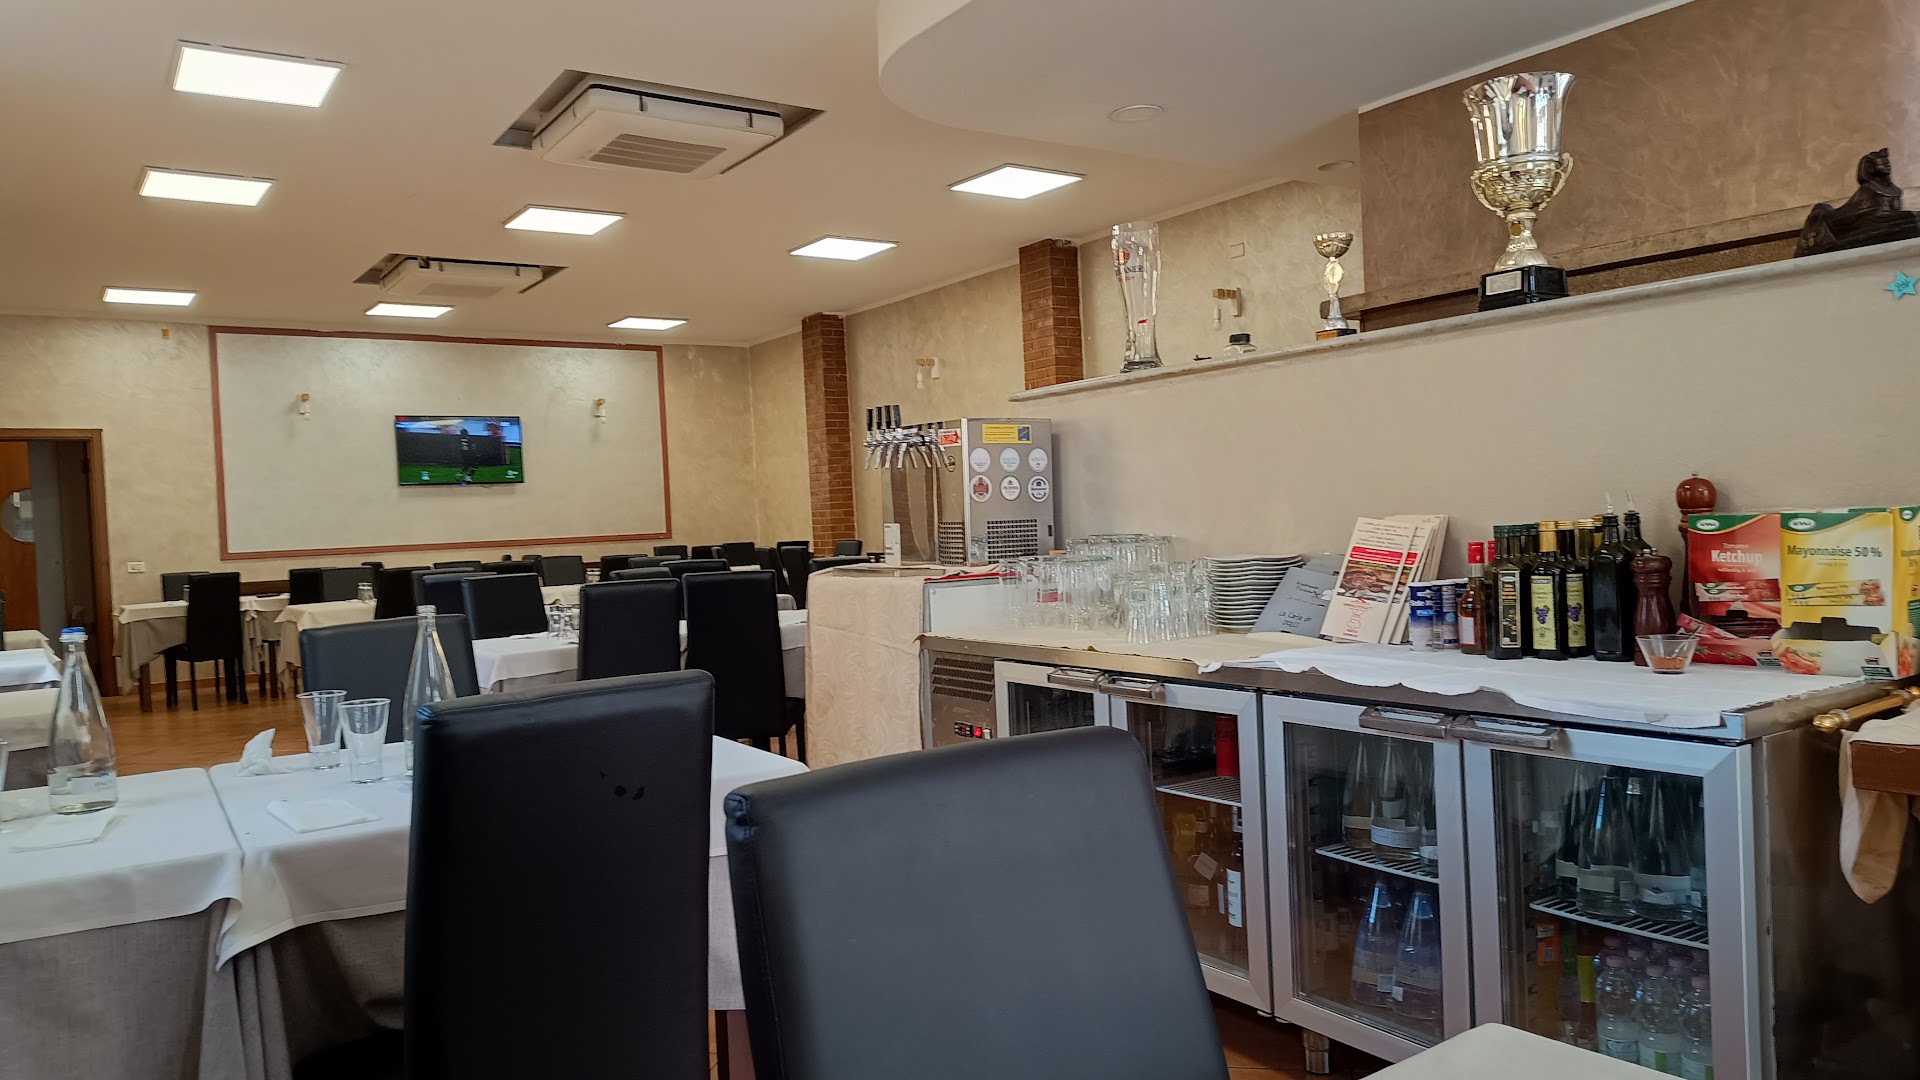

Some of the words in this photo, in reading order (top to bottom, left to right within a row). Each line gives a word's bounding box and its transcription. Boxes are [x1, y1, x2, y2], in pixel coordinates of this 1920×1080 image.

[1711, 549, 1763, 565] Ketchup
[1787, 545, 1852, 559] Mayonnaise
[1854, 546, 1869, 557] 50
[1871, 547, 1883, 557] %
